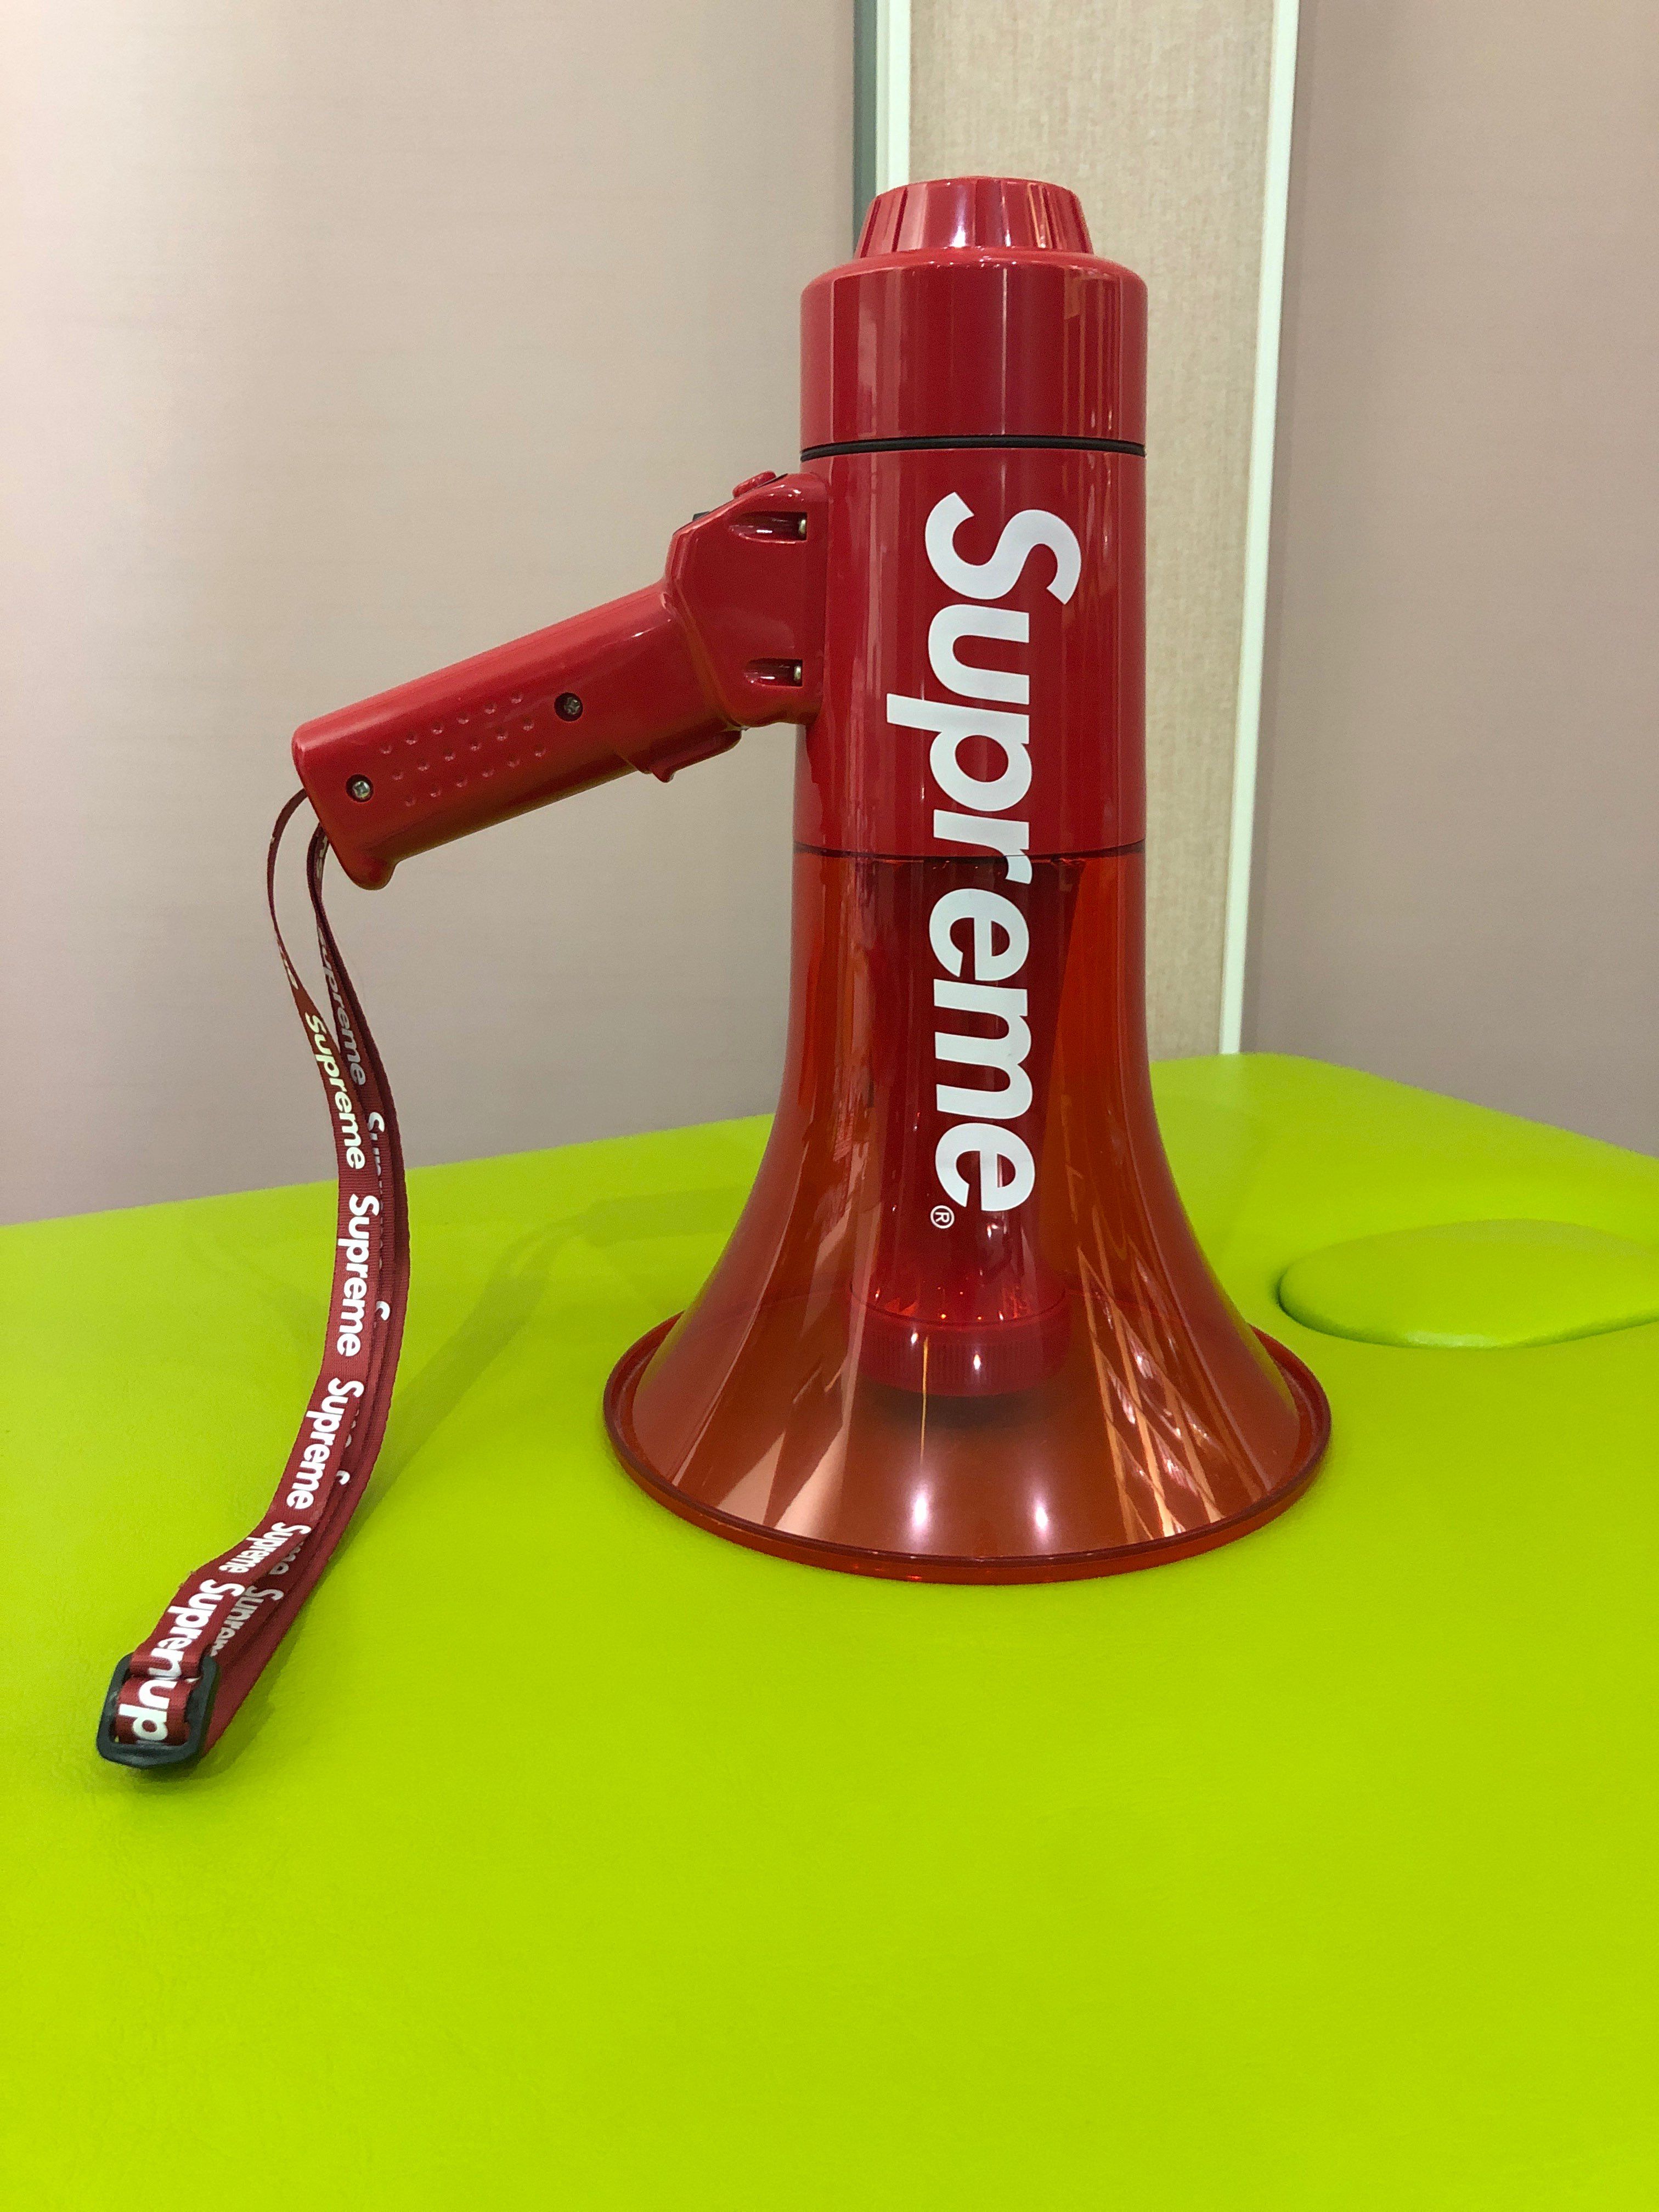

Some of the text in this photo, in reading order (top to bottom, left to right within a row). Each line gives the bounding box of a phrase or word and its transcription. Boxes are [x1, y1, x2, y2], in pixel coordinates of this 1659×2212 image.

[886, 492, 1082, 1212] Supreme
[304, 1012, 365, 1170] Supreme
[336, 1193, 380, 1357] Supreme
[286, 1377, 364, 1510] Supreme
[218, 1522, 312, 1573] Supreme
